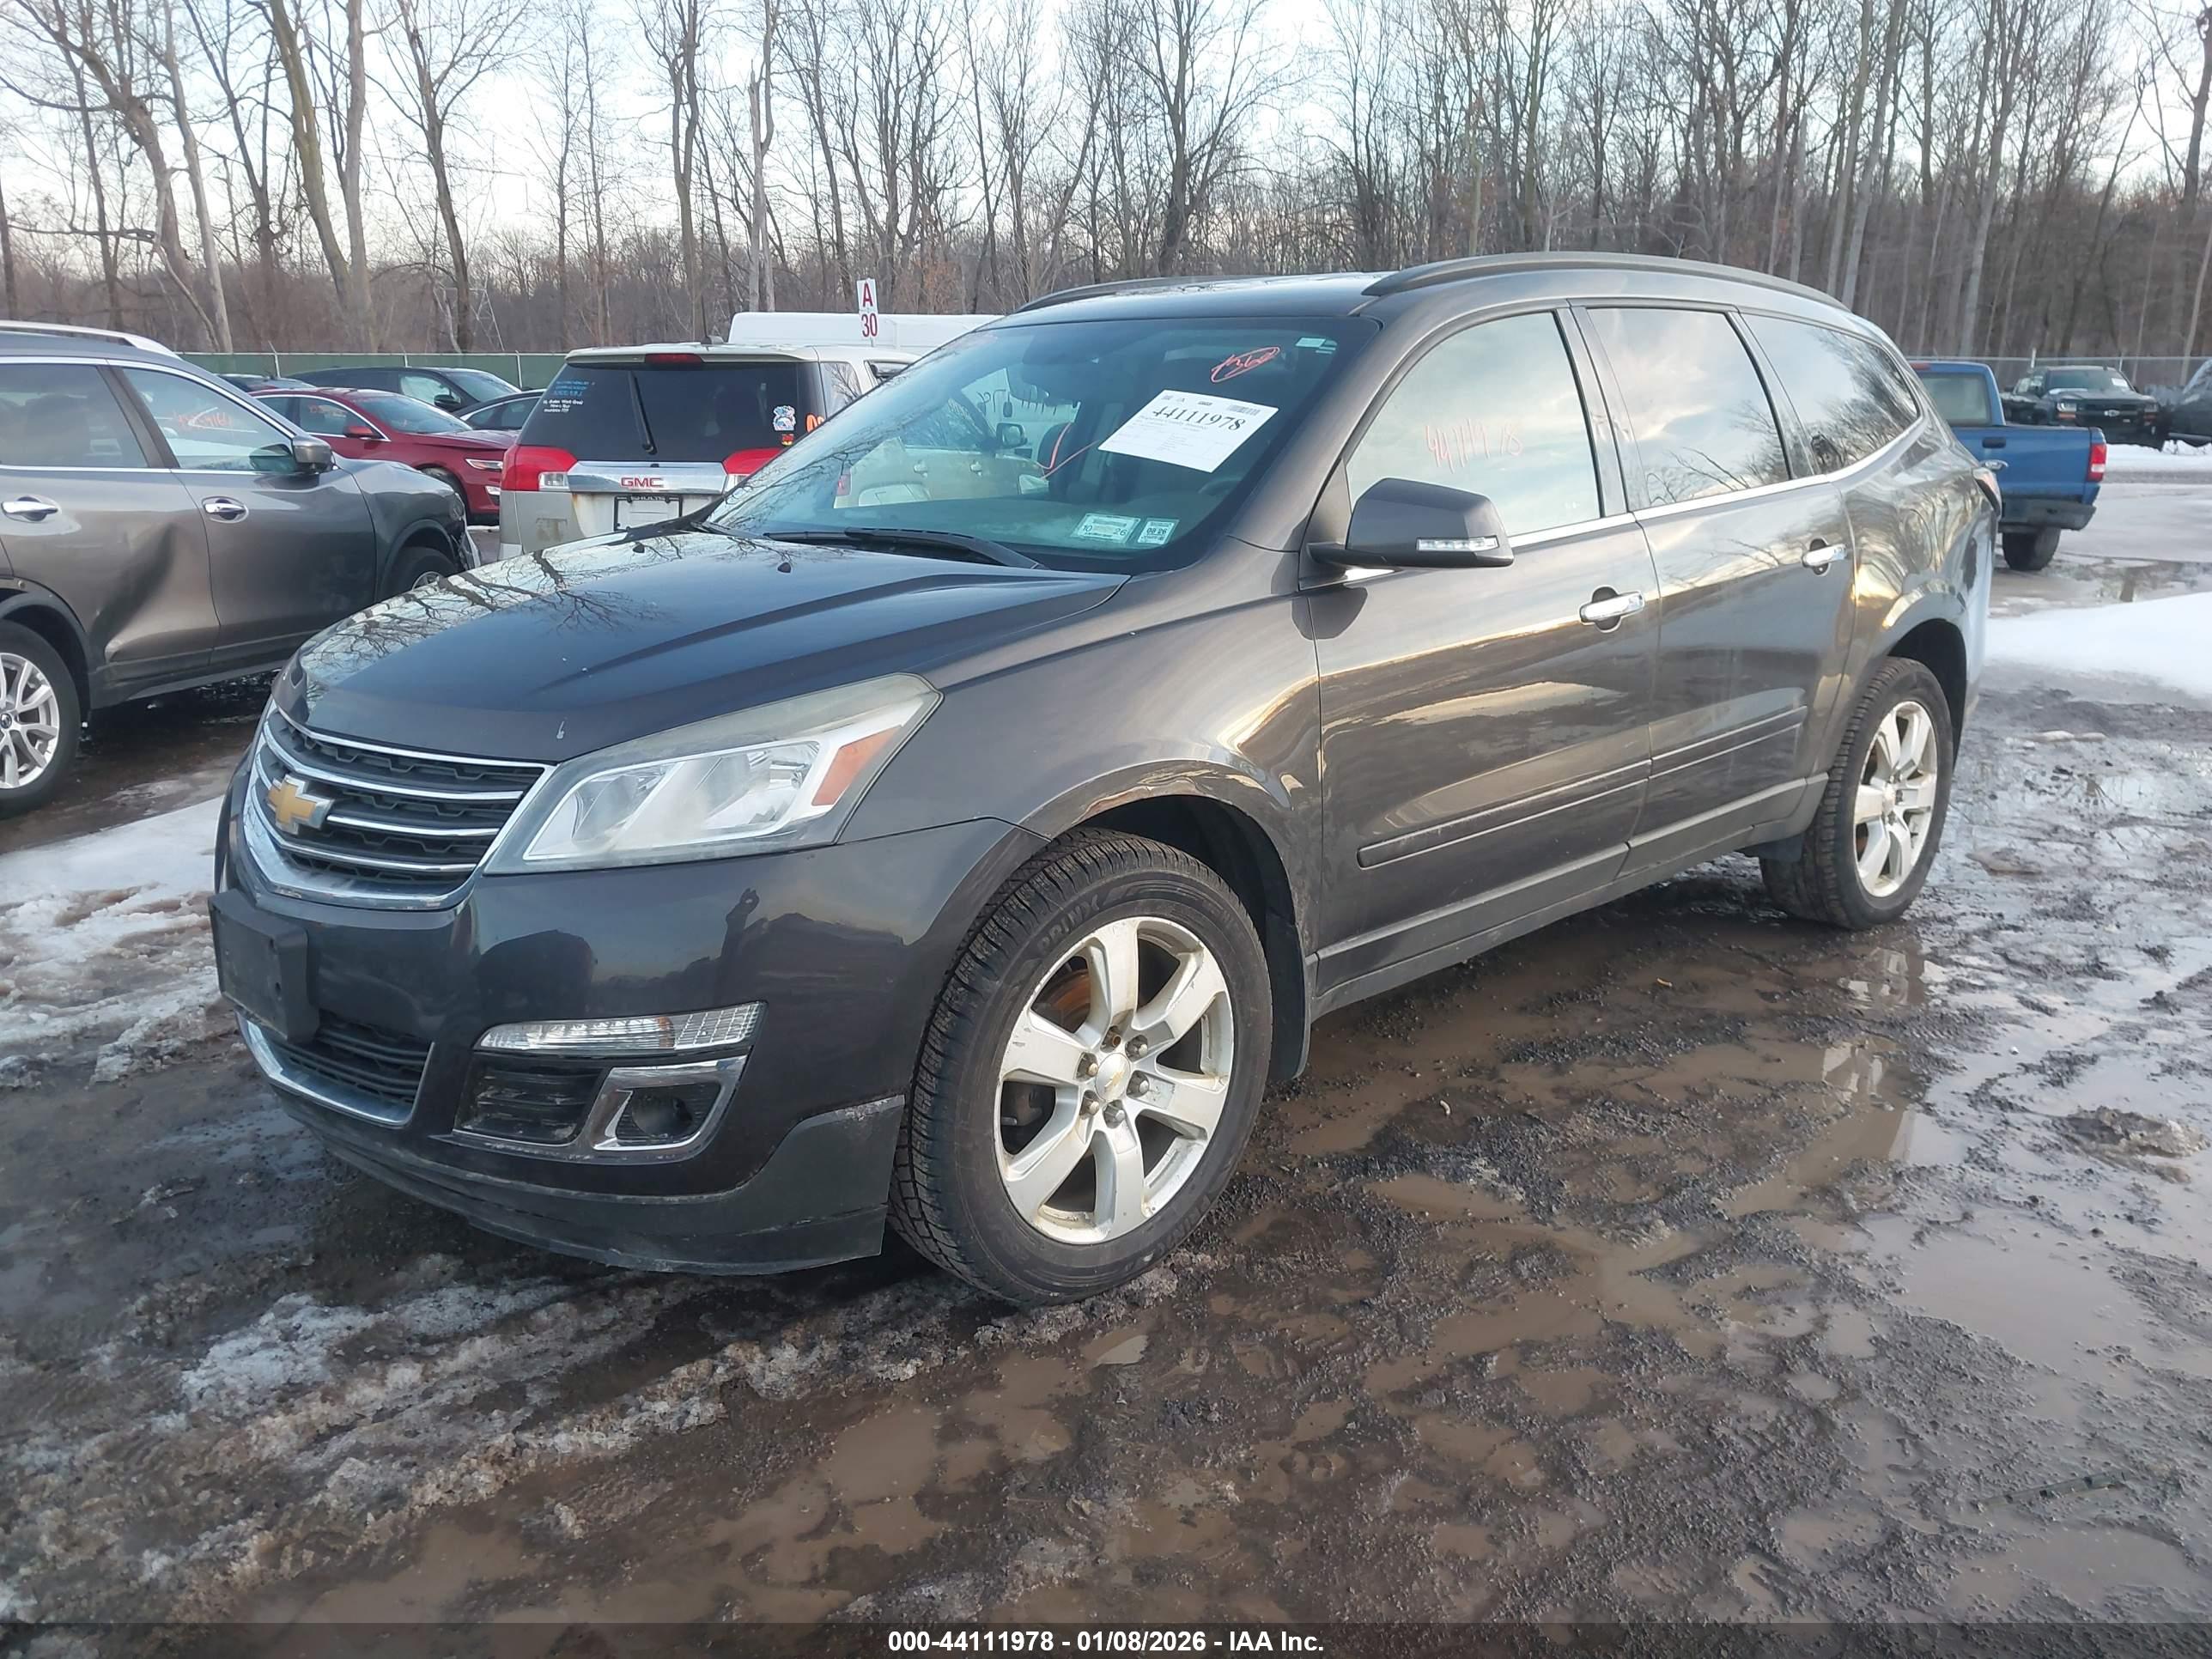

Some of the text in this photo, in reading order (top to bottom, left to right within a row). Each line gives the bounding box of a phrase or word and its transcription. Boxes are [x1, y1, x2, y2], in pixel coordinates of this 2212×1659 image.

[863, 282, 873, 307] A
[861, 313, 878, 337] 30
[1152, 405, 1246, 431] 44111978
[621, 477, 664, 489] GMC
